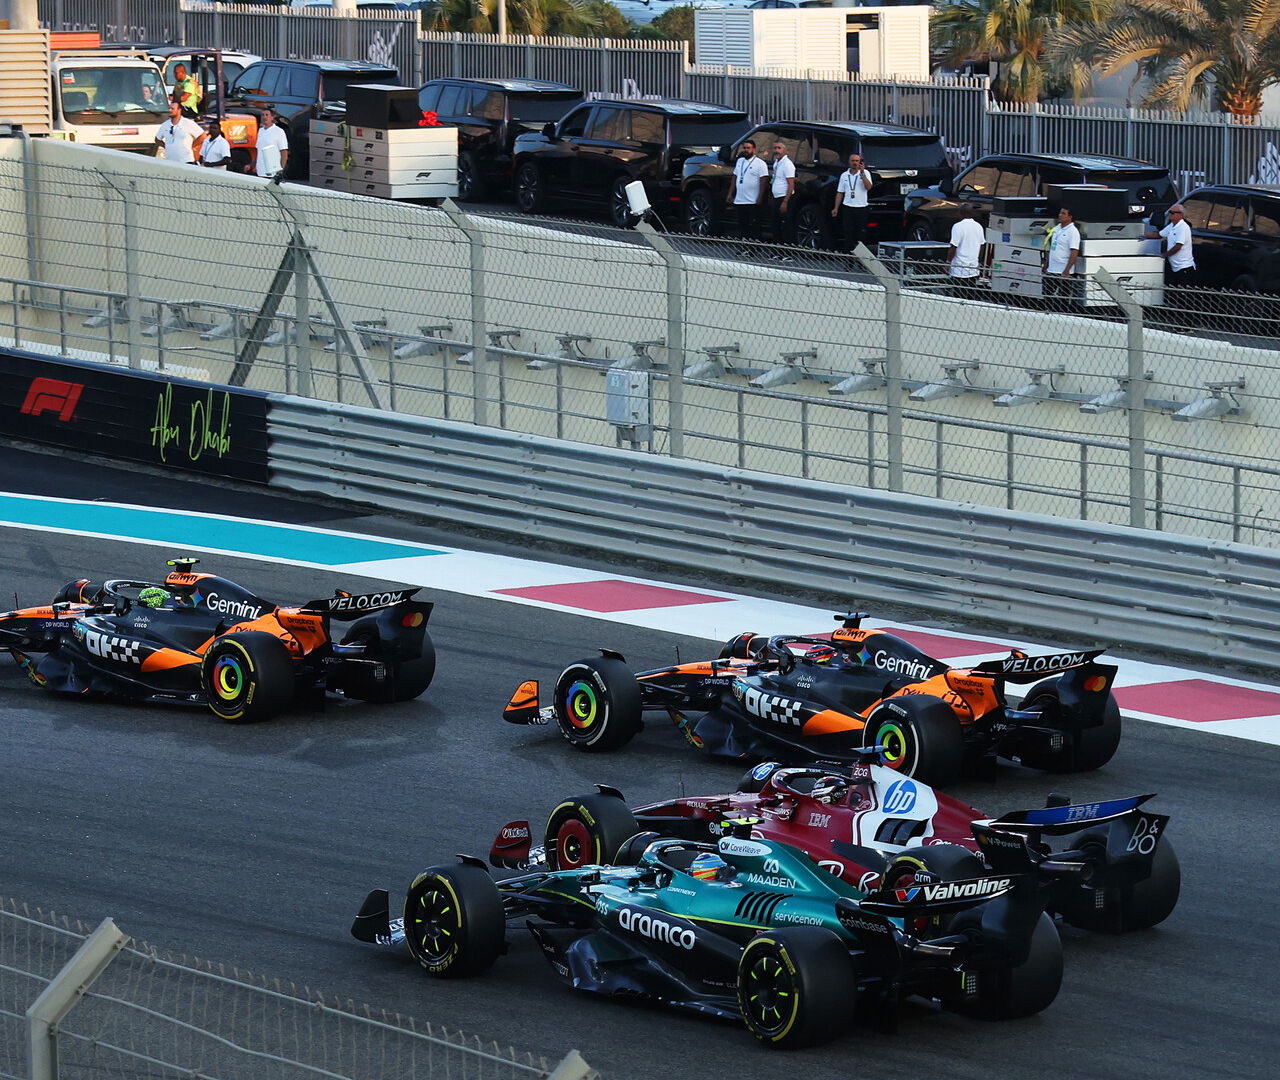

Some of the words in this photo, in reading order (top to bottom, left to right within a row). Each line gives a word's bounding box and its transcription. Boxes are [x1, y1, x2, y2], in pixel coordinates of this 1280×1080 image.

[150, 382, 179, 462] Abu
[189, 388, 232, 461] Dhabi
[206, 592, 261, 620] Gemini
[328, 591, 404, 611] VELO.COM
[874, 649, 934, 681] Gemini
[1001, 652, 1086, 673] VELO.COM
[883, 779, 914, 815] hp
[808, 812, 832, 829] IBM
[1068, 804, 1101, 822] IBM
[730, 843, 762, 855] CoreWeave
[986, 835, 1021, 848] V-Power
[747, 872, 797, 889] MAADEN
[914, 873, 932, 884] arm
[923, 878, 1011, 902] Valvoline
[774, 911, 824, 927] servicenow
[840, 916, 888, 934] coinbase
[619, 908, 696, 951] aramco
